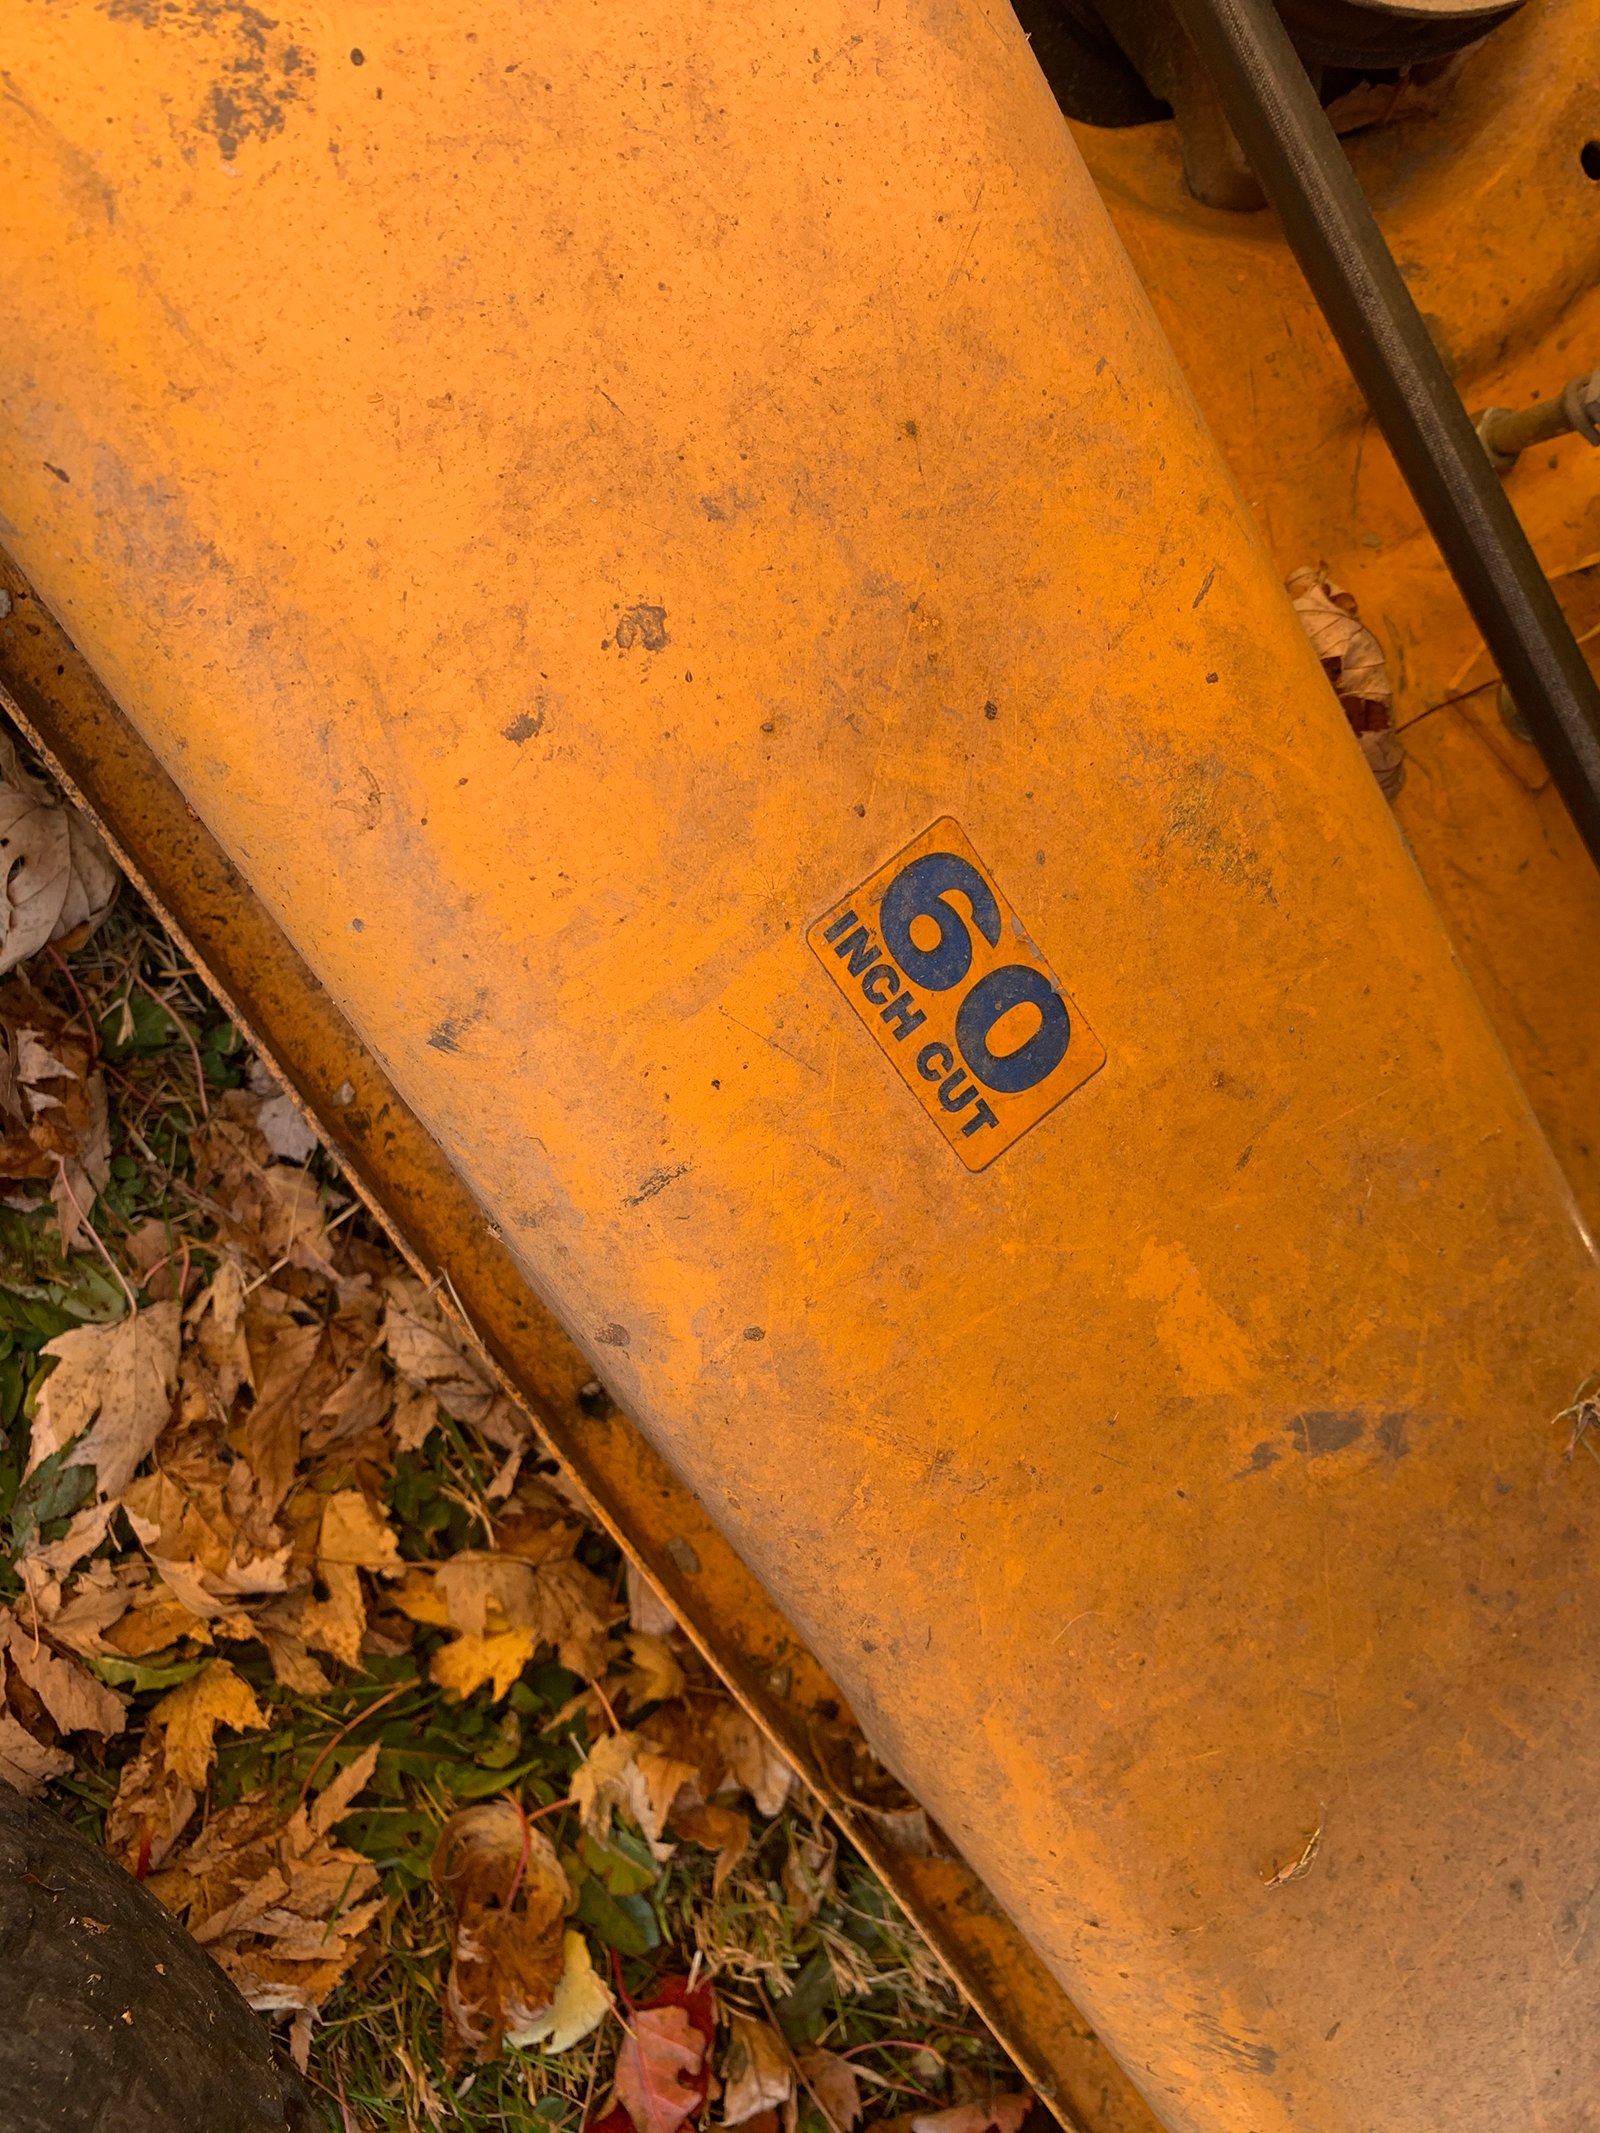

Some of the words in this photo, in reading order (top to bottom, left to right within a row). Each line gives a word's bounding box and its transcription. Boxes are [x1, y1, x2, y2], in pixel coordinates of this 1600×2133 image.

[823, 910, 927, 1041] INCH
[916, 1041, 999, 1138] CUT
[880, 852, 1071, 1093] 60
